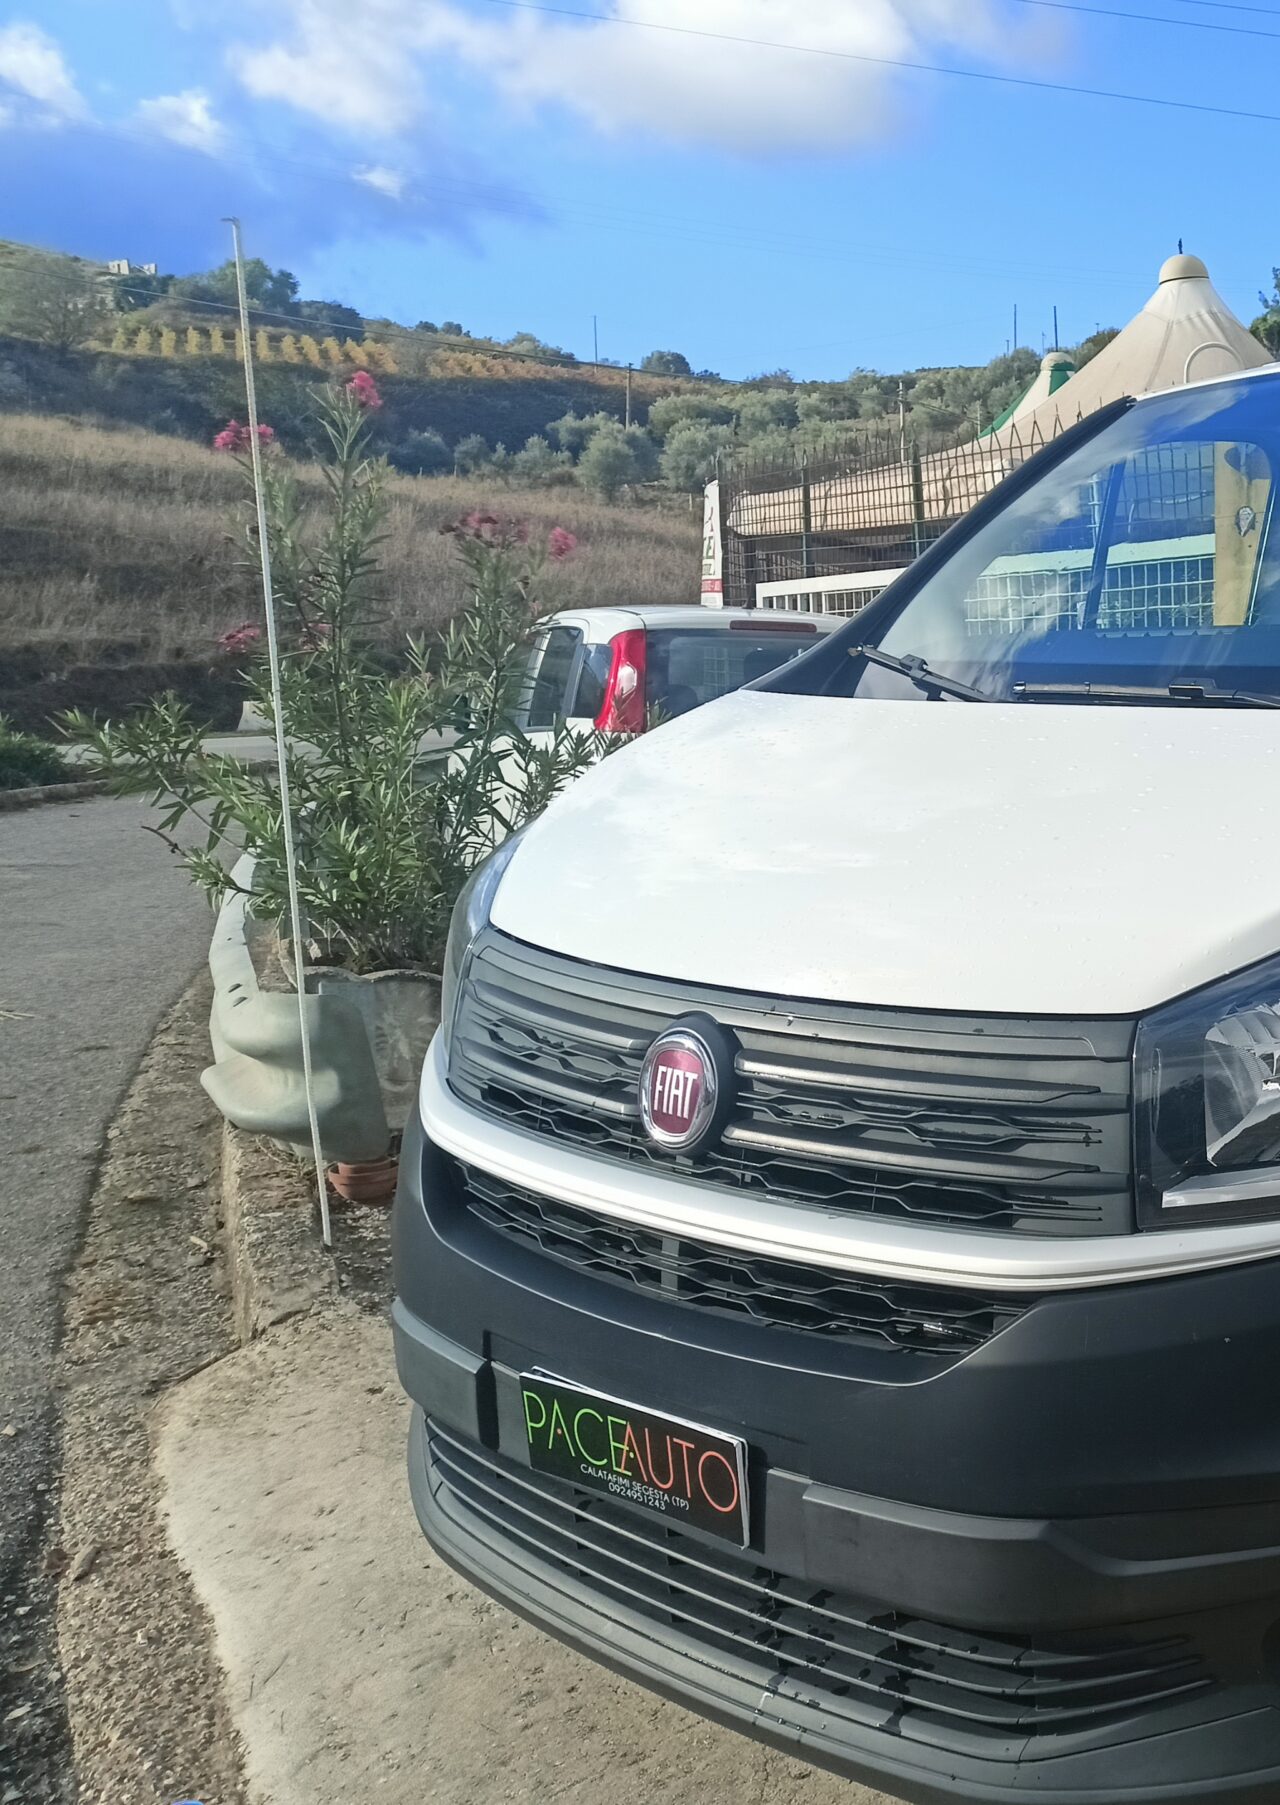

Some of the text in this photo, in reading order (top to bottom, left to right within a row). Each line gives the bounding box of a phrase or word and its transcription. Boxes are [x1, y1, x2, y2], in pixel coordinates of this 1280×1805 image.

[653, 1064, 698, 1119] FIAT
[580, 1463, 631, 1488] CALATAFIMI
[671, 1495, 690, 1511] (TP)
[608, 1482, 666, 1511] 0924951243
